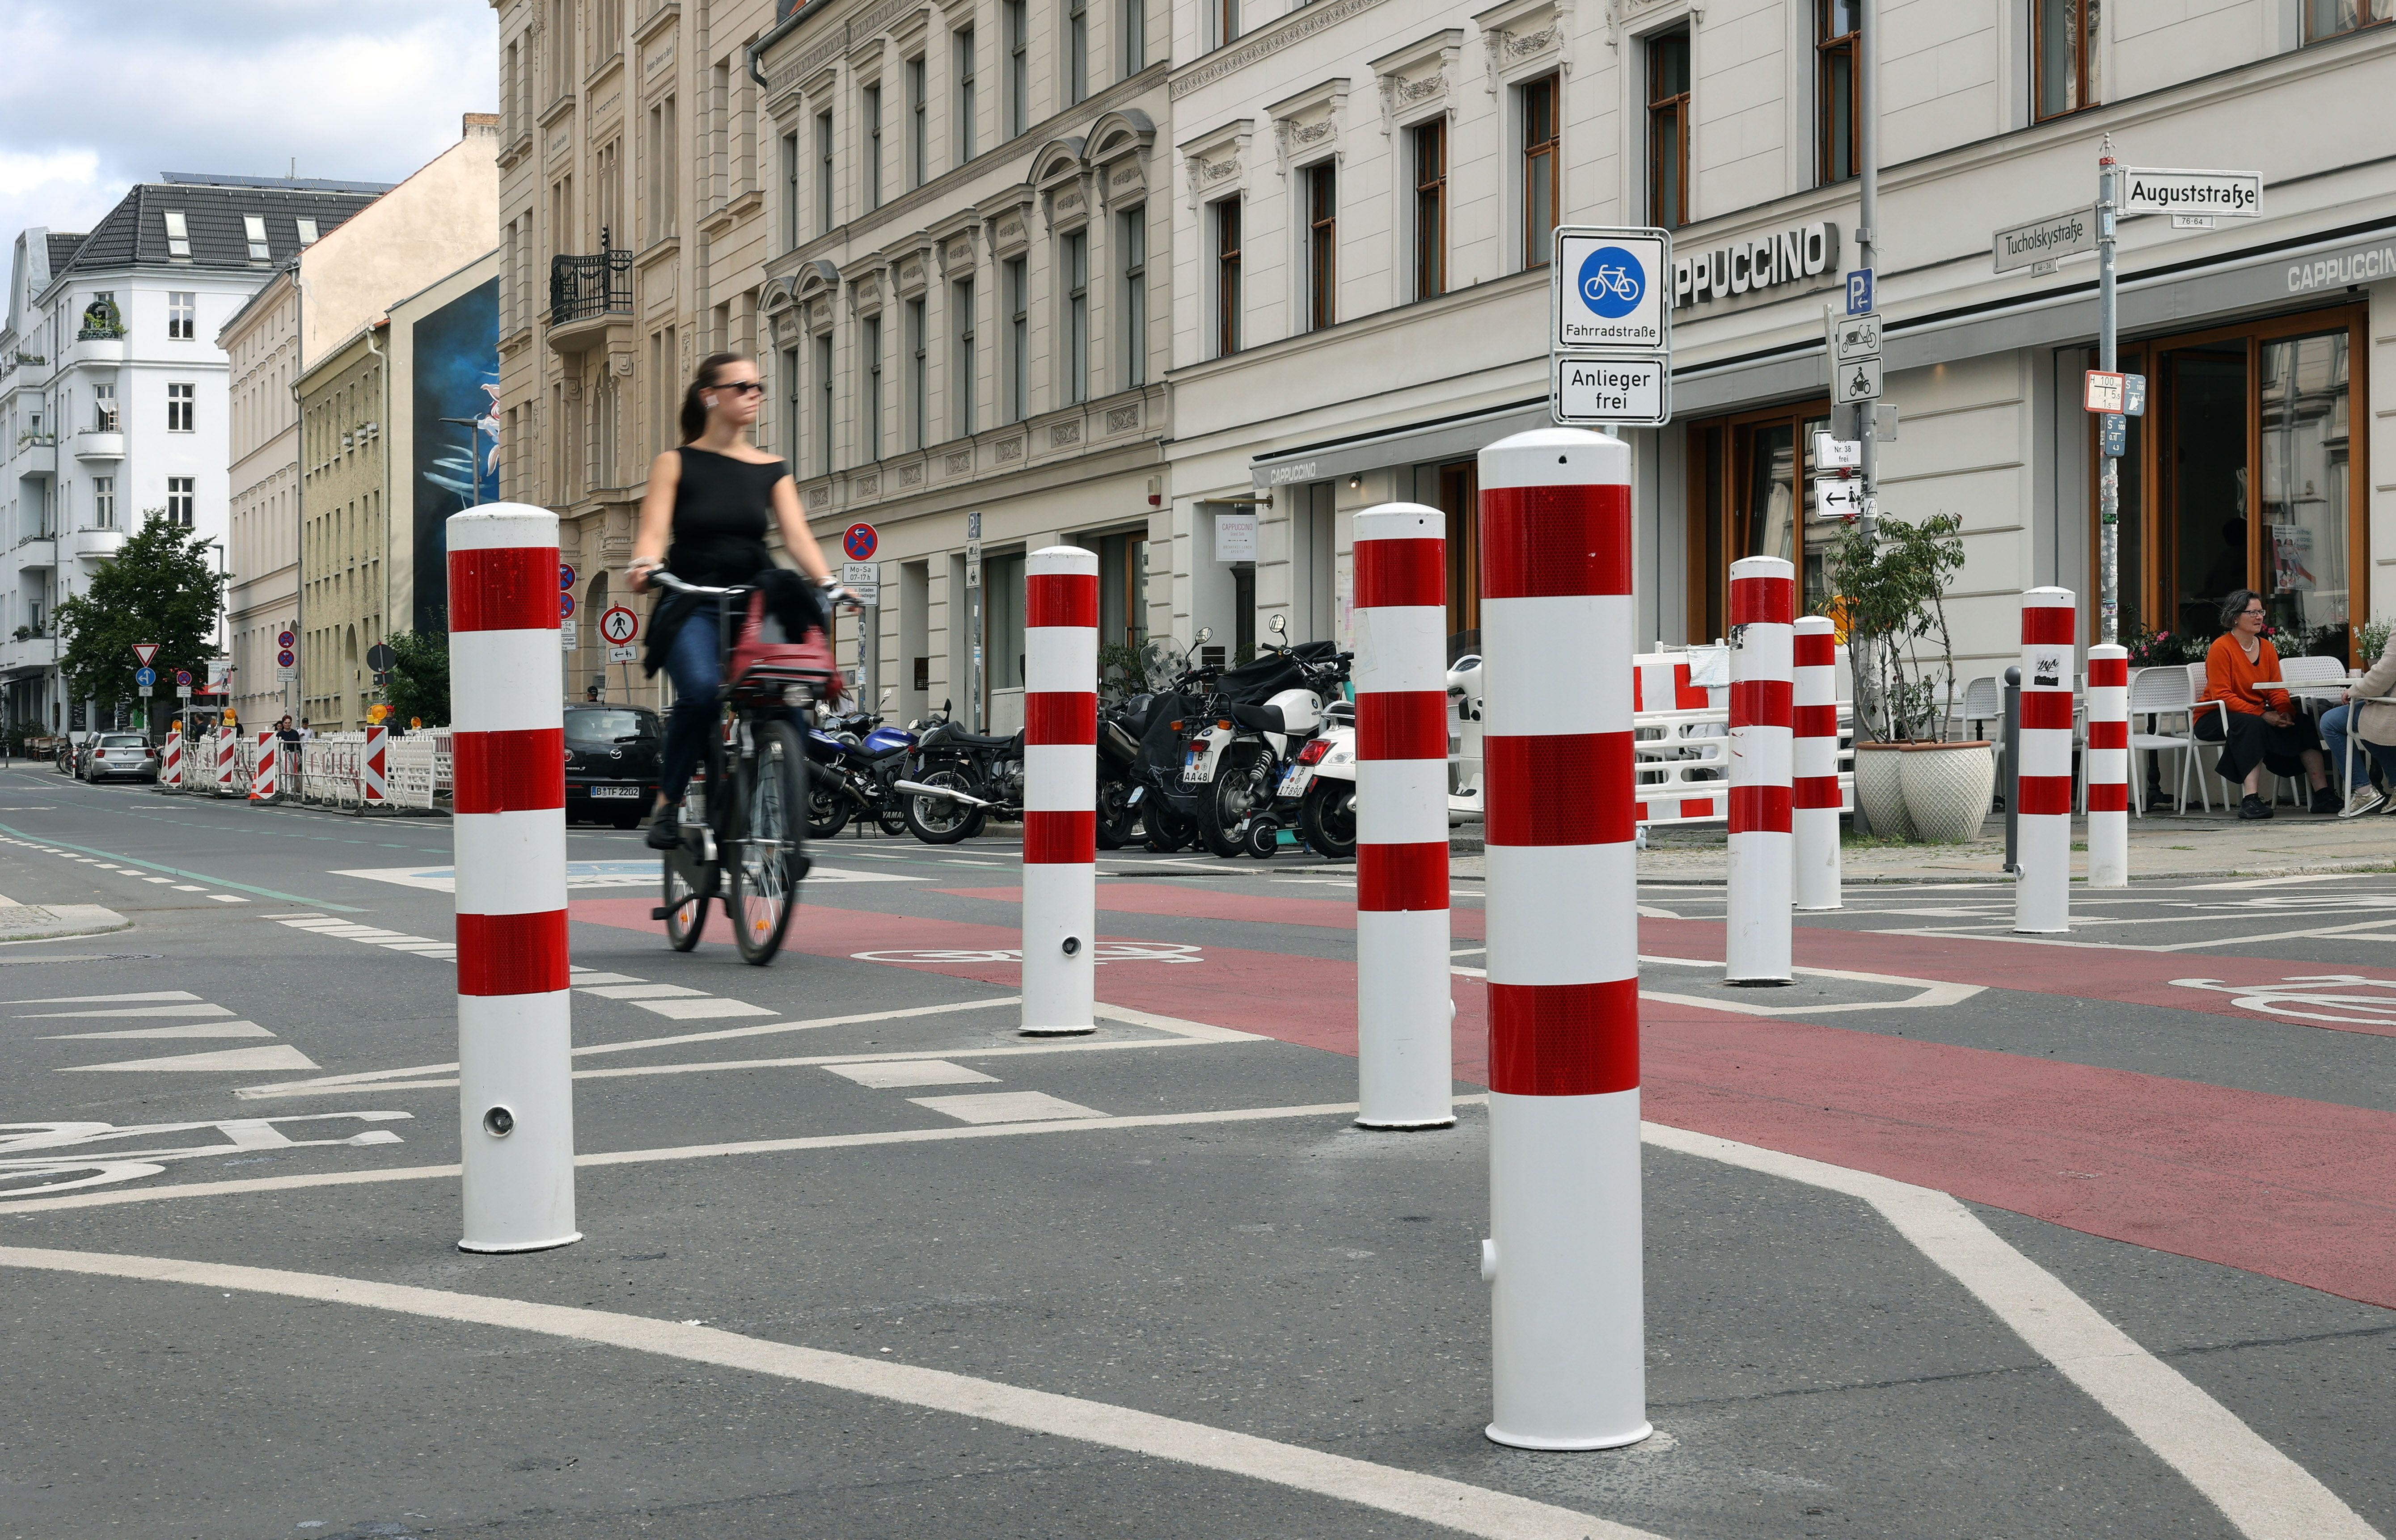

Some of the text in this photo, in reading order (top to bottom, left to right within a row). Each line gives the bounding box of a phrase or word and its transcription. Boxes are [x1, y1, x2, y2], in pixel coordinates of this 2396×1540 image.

[2130, 180, 2255, 209] Auguststraße
[2005, 218, 2083, 256] Tucholskystraße
[1566, 324, 1656, 338] Fahrradstraße
[1571, 369, 1651, 391] Anlieger
[2090, 376, 2114, 386] H 100
[2126, 380, 2131, 389] S
[1596, 393, 1627, 409] frei
[2108, 420, 2113, 430] S
[1271, 462, 1316, 484] CAPPUCCINO
[1197, 752, 1203, 761] B
[1299, 767, 1306, 776] B
